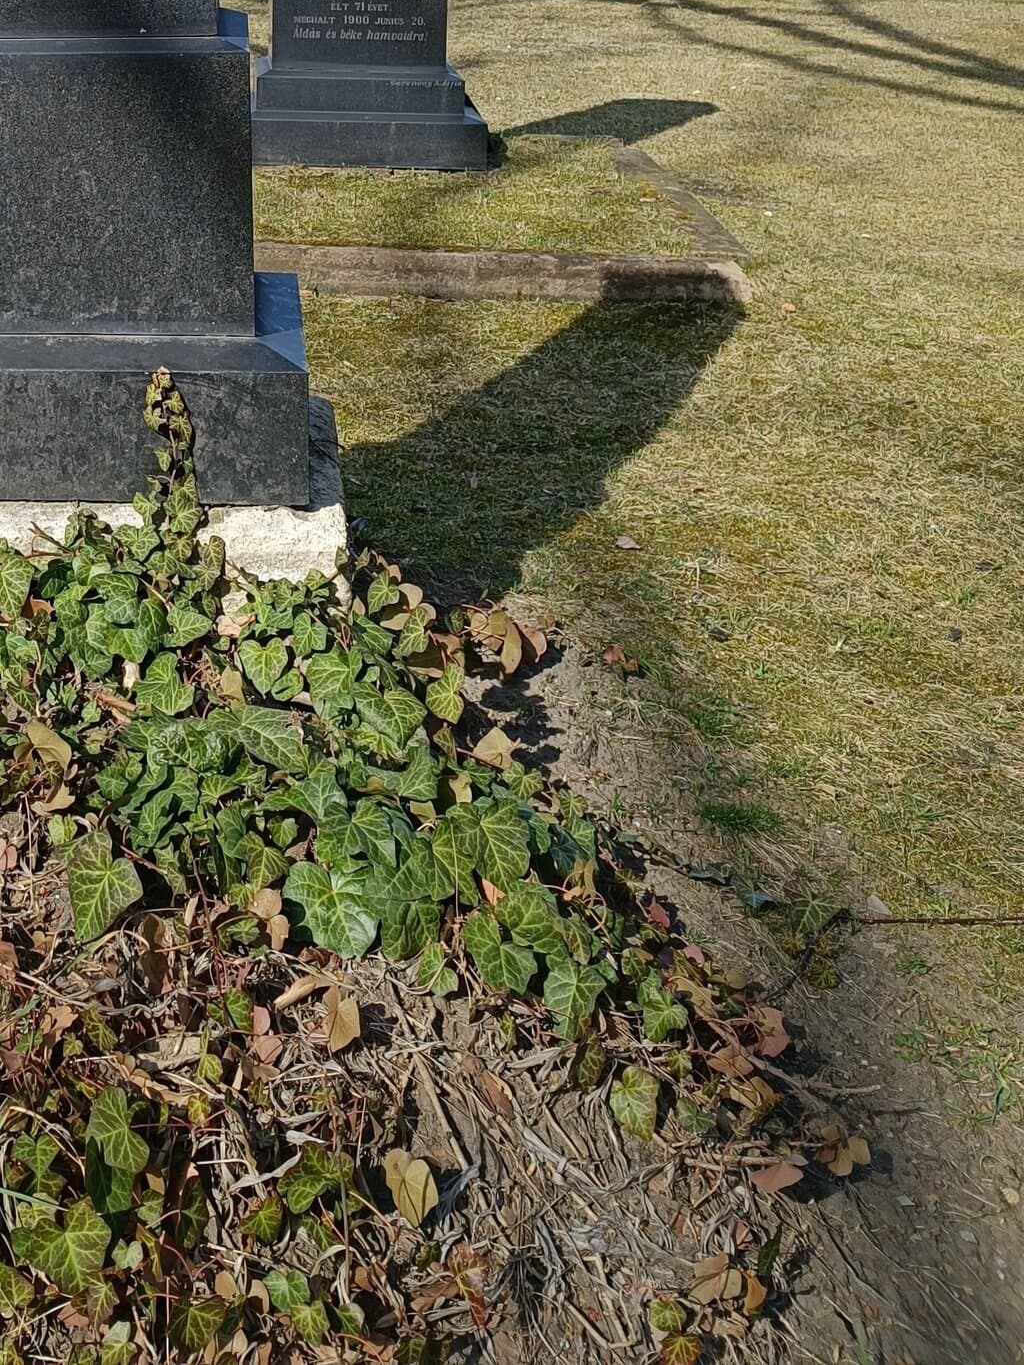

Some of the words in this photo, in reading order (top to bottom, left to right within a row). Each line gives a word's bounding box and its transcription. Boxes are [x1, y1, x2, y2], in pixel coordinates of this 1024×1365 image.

[330, 0, 350, 11] ÉLT
[343, 14, 370, 25] 1900
[326, 28, 337, 40] és
